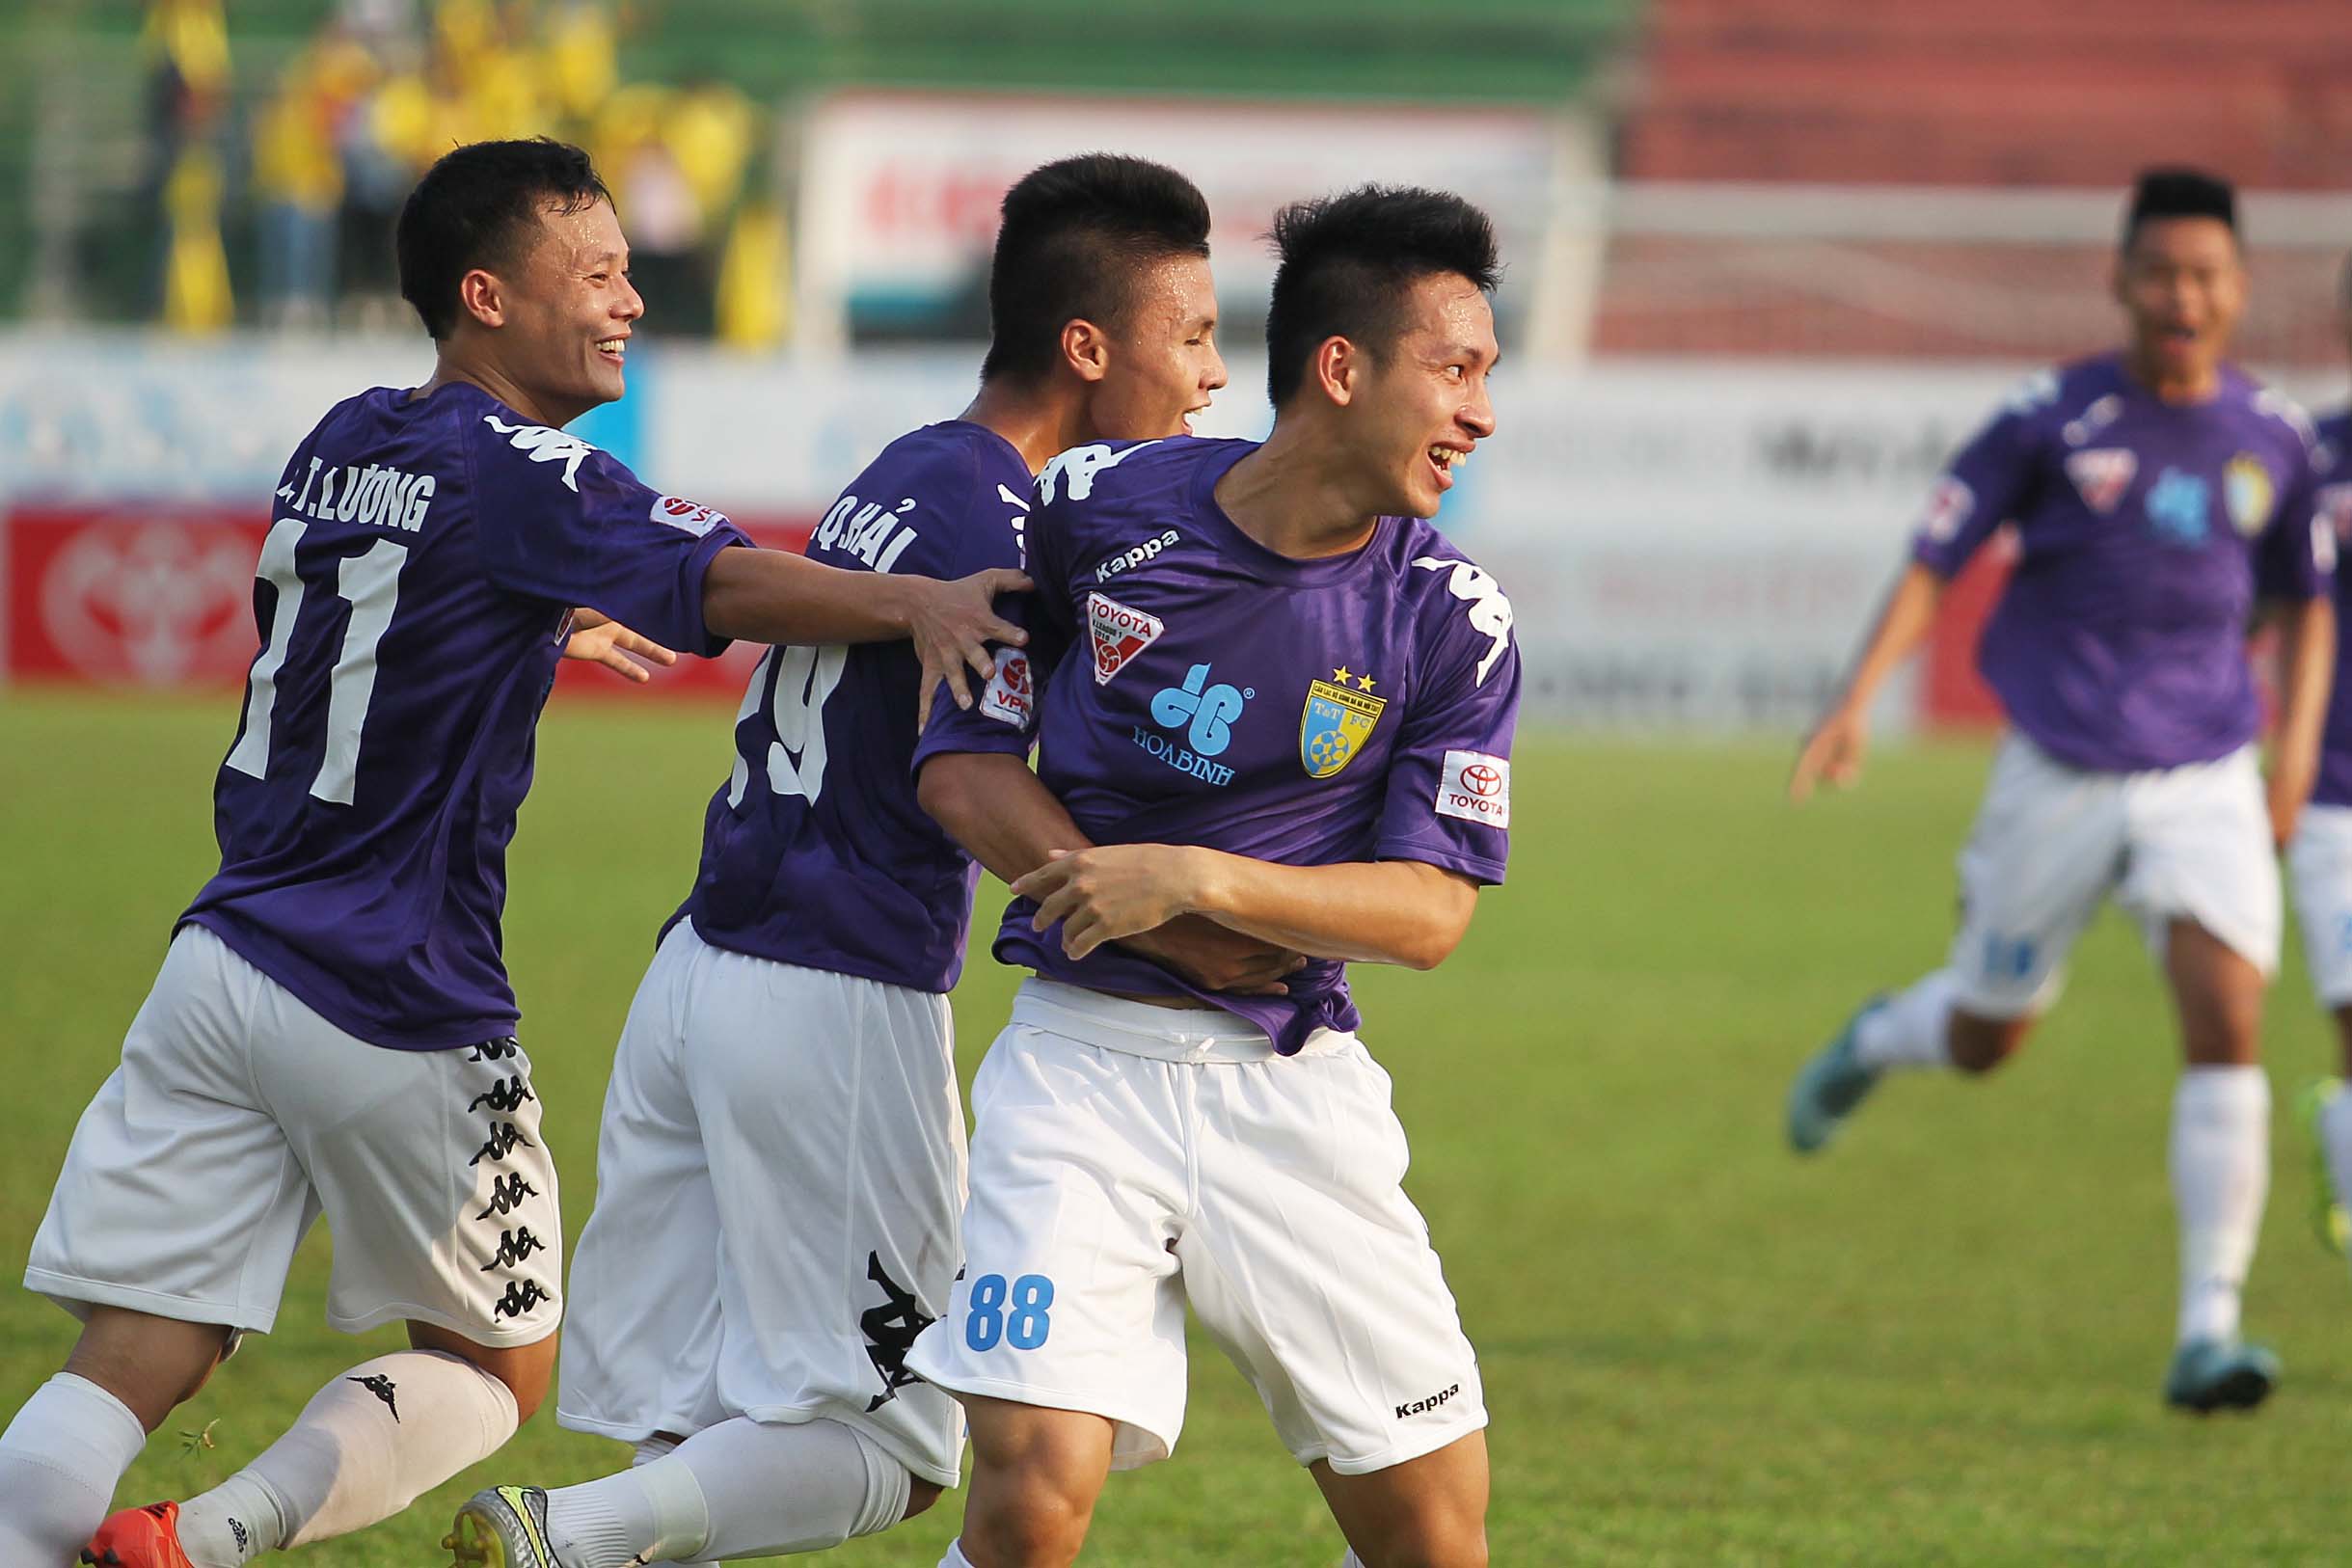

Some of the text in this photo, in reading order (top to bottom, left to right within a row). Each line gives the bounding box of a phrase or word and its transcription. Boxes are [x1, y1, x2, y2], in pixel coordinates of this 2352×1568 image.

[1095, 529, 1180, 583] Kappa
[1092, 599, 1151, 637] TOYOTA
[226, 518, 409, 806] 11
[1449, 793, 1503, 817] TOYOTA
[965, 1273, 1055, 1352] 88
[1395, 1383, 1459, 1419] Kappa
